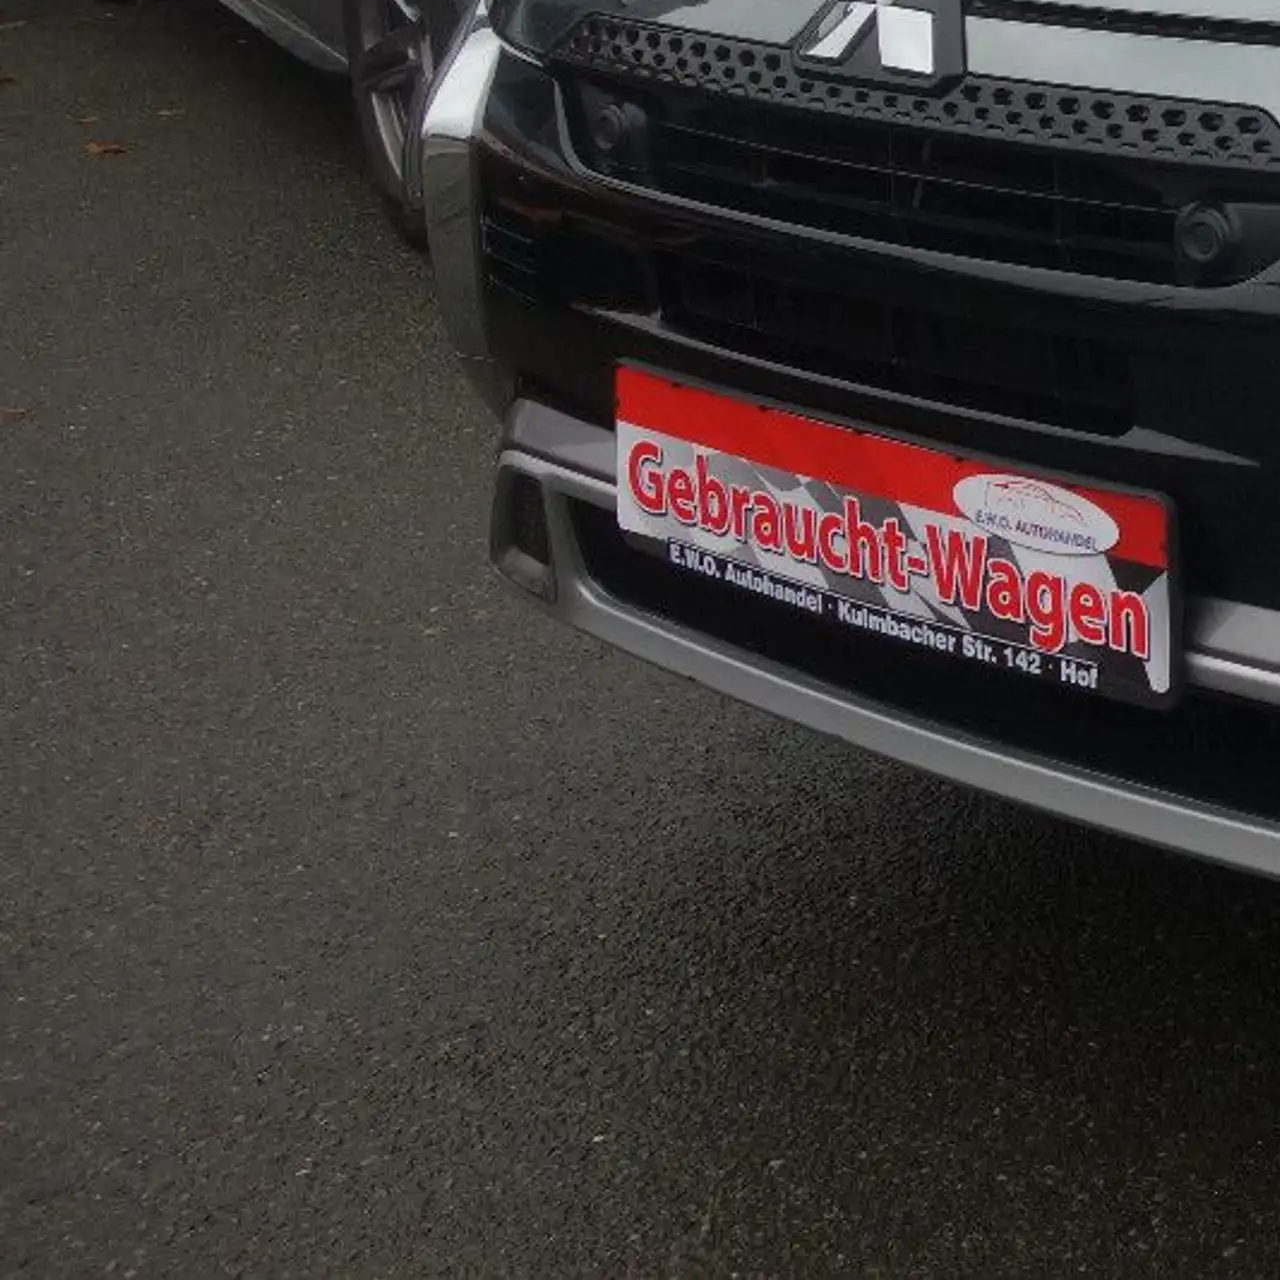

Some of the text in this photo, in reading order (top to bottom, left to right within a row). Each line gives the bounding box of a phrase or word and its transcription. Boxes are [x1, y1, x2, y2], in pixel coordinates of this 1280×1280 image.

[625, 438, 1151, 661] Gebraucht-Wagen
[1014, 519, 1098, 552] AUTOHANDEL
[669, 542, 1099, 689] E.W.O. Autohandel Kulmbacher Str. 142 Hof
